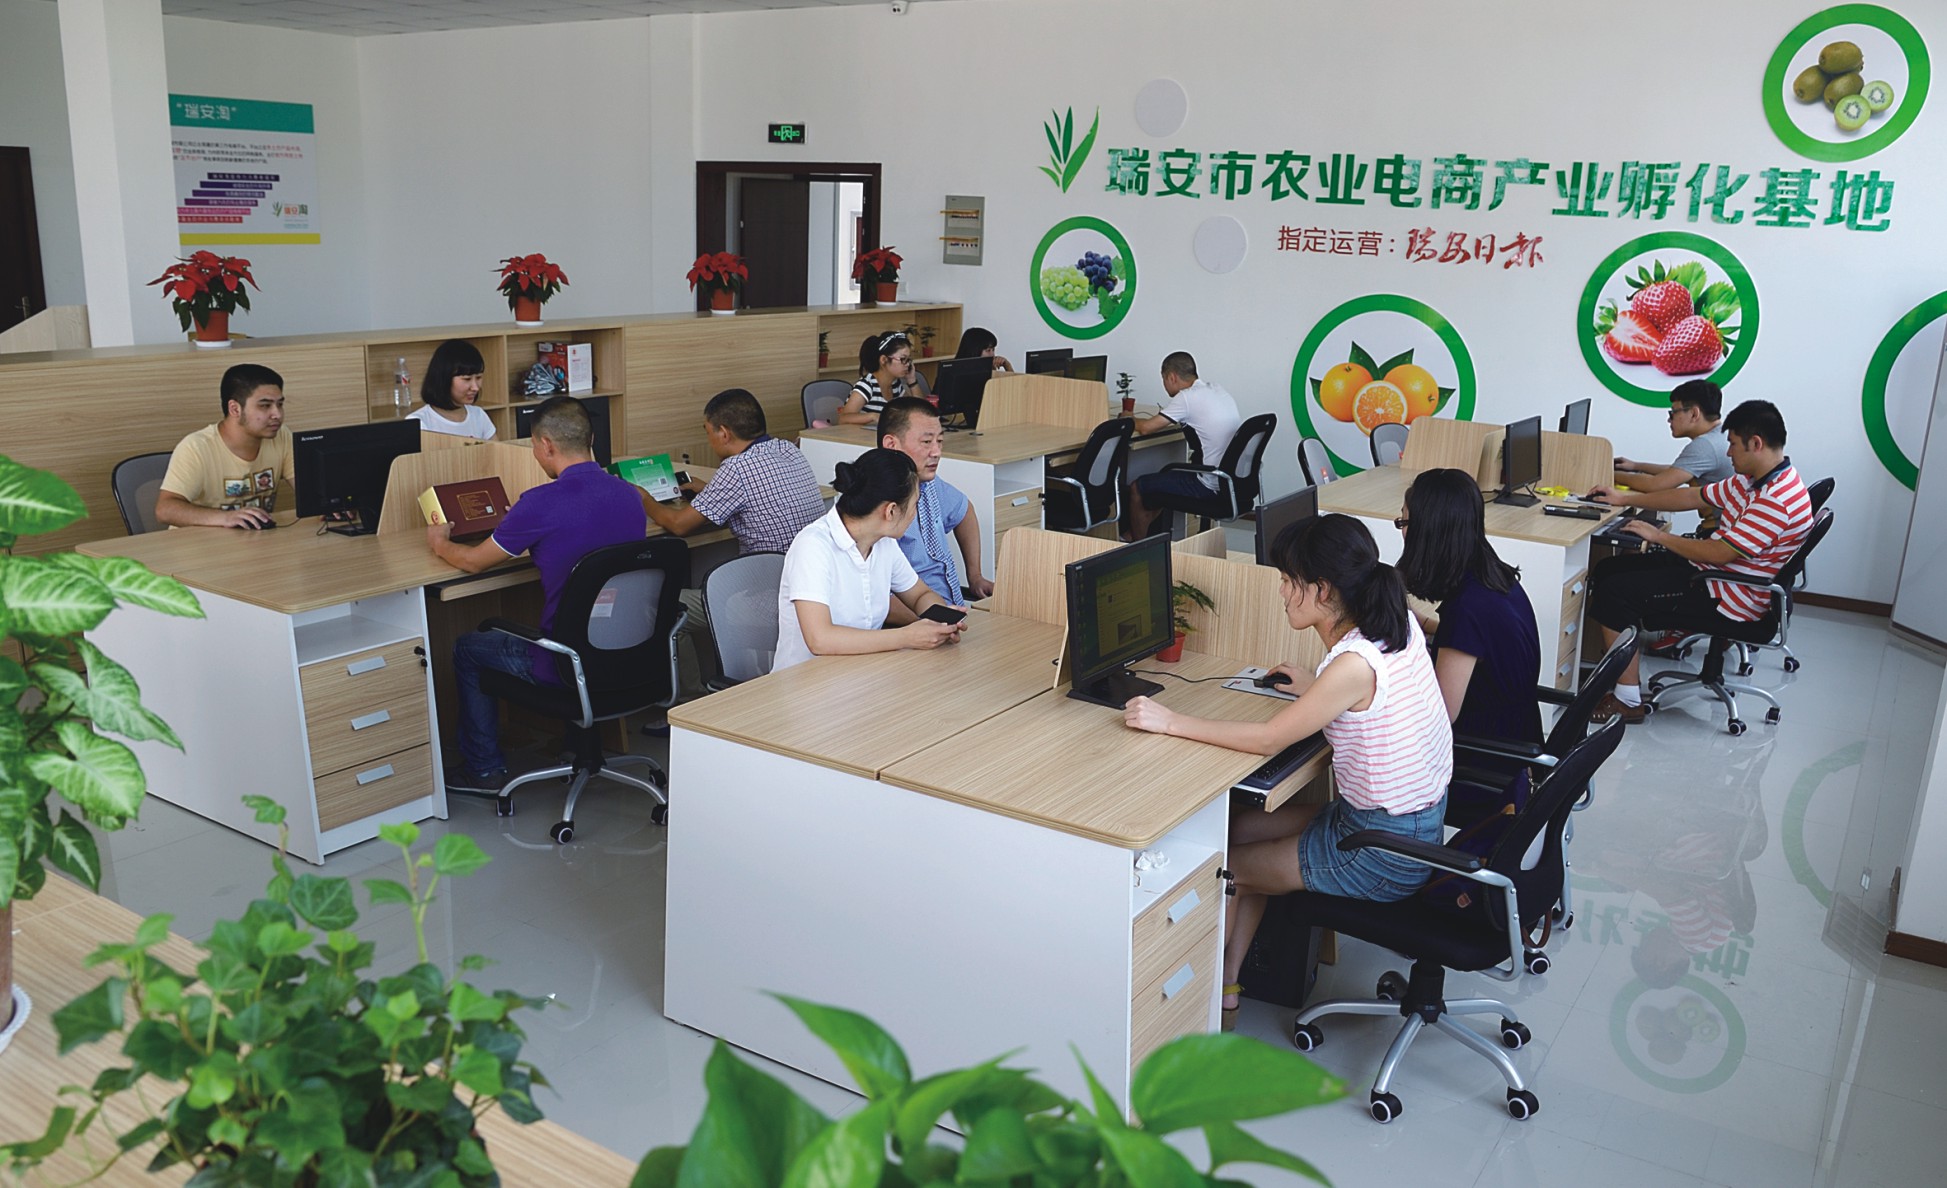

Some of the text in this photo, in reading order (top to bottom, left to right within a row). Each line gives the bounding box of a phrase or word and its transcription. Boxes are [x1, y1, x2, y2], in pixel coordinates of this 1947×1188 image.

[1104, 147, 1895, 232] 瑞安市农业电商产业孵化基地
